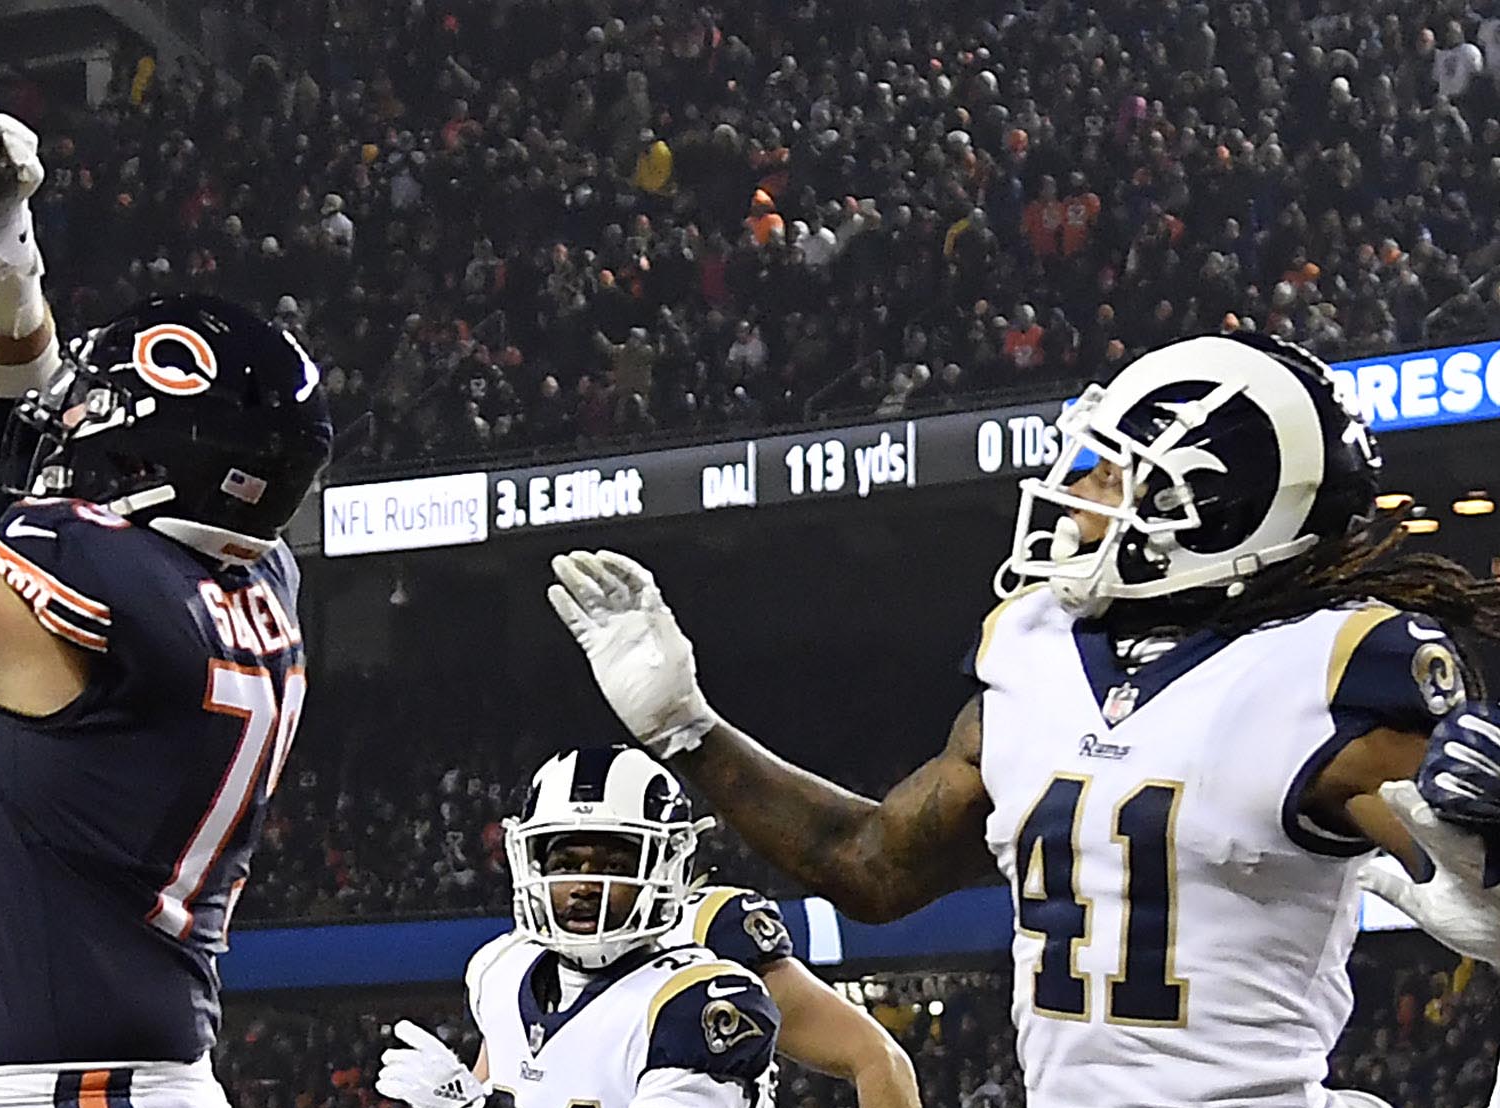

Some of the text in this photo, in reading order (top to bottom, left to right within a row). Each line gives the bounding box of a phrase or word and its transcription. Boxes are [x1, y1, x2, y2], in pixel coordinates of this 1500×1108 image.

[496, 480, 526, 528] 3.
[529, 468, 643, 526] E.Elliott
[785, 440, 844, 494] 113
[854, 432, 904, 496] yds
[978, 420, 1002, 472] 0
[1008, 416, 1058, 468] TDs
[331, 492, 479, 536] NFL Rushing
[1079, 733, 1132, 759] Rams
[1014, 771, 1190, 1028] 41
